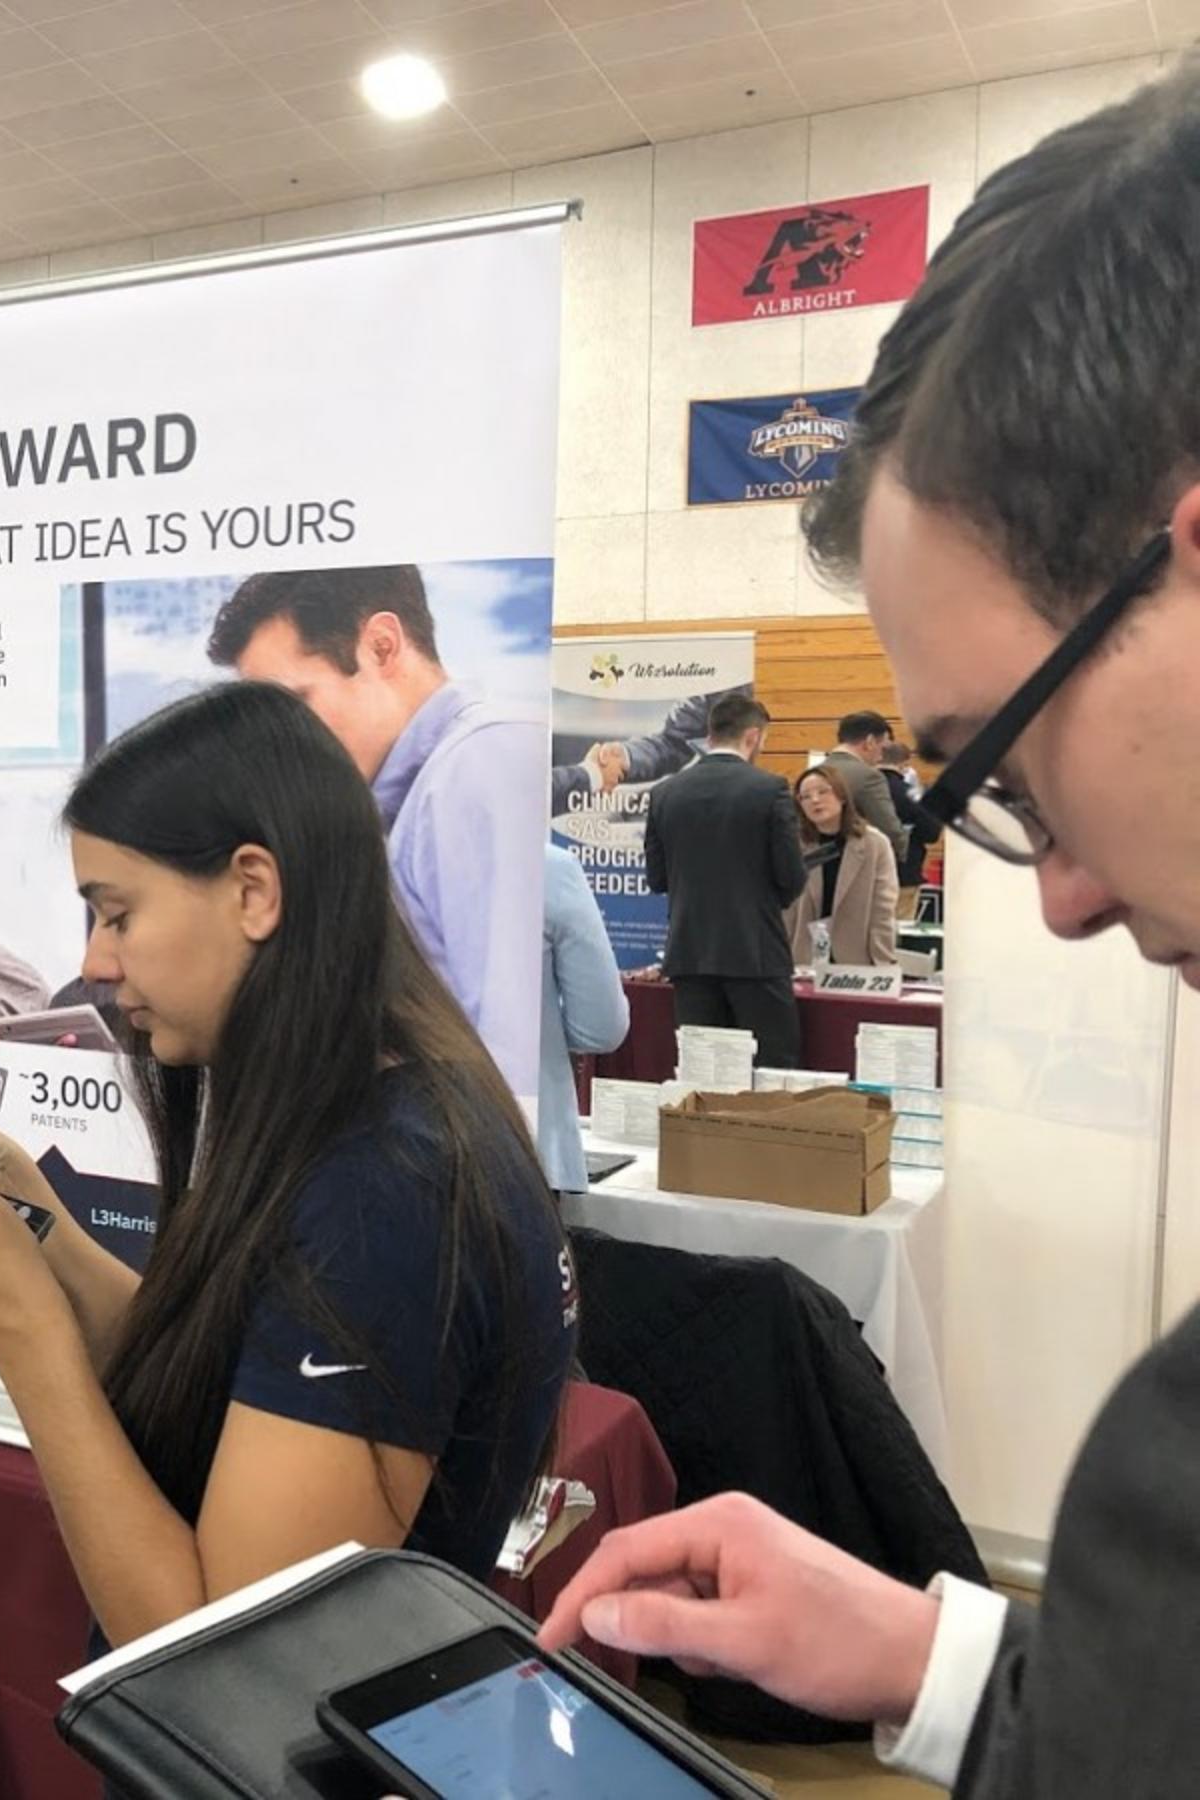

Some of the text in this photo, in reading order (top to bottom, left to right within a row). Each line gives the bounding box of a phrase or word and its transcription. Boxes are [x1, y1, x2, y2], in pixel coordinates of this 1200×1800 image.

[753, 290, 856, 317] ALBRIGHT
[754, 421, 845, 447] LYCOMING
[34, 517, 131, 562] IDEA
[145, 512, 188, 555] IS
[200, 499, 356, 551] YOURS
[567, 817, 610, 840] SAS
[585, 872, 651, 896] EEDED
[821, 973, 894, 991] Table 23
[31, 1113, 88, 1132] PATENTS
[91, 1207, 157, 1234] L3Harris
